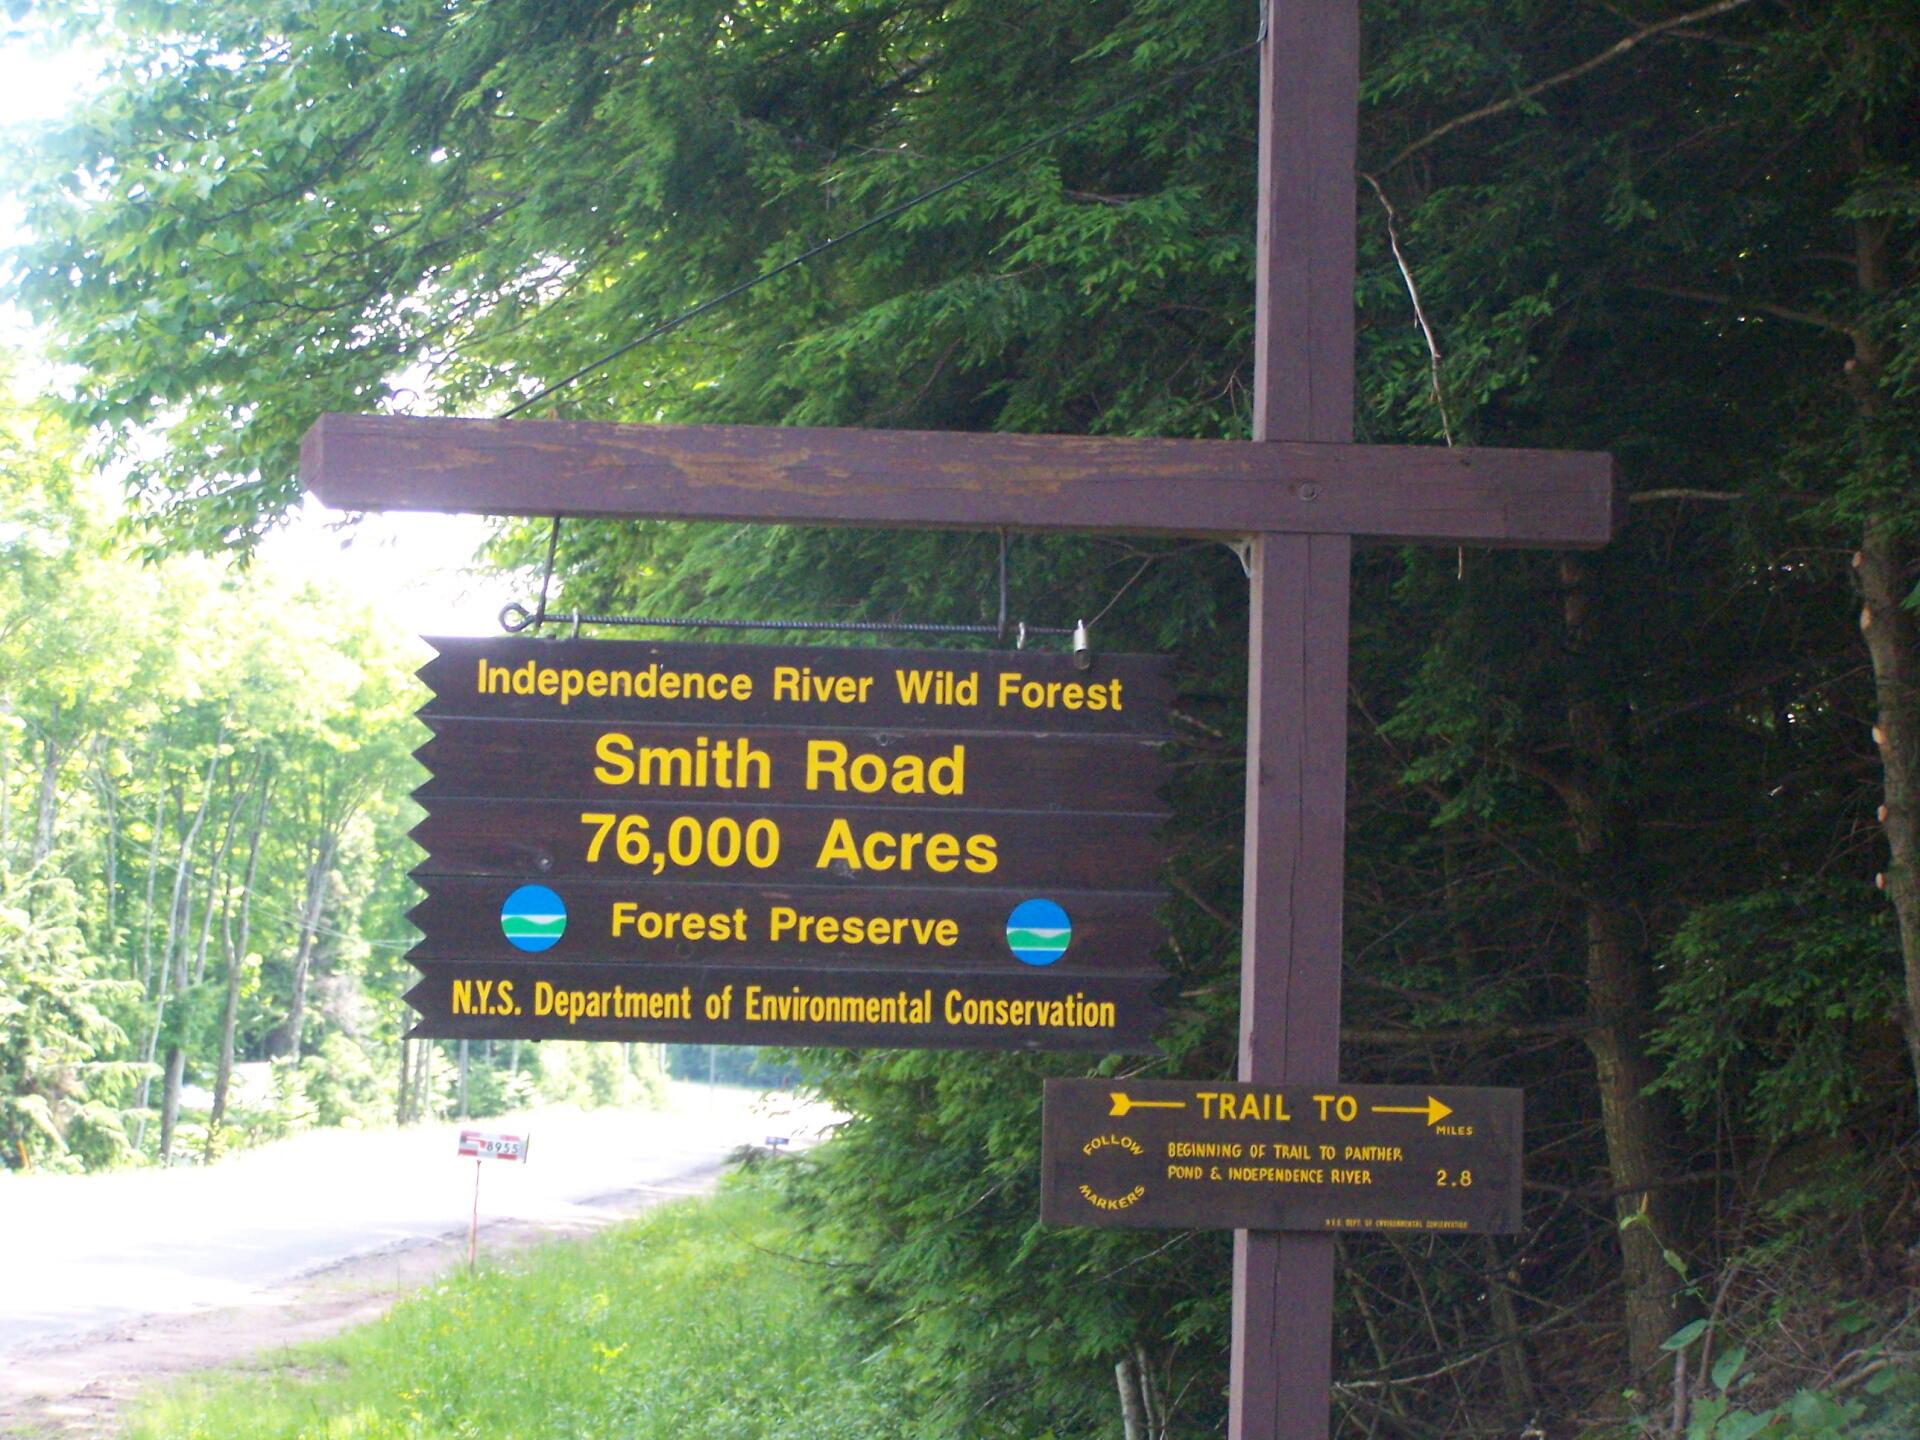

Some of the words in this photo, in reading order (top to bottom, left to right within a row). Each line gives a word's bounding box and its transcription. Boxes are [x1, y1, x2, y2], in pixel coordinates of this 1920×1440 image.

[477, 659, 753, 705] Independence
[773, 666, 874, 704] River
[895, 669, 979, 707] Wild
[998, 672, 1123, 711] Forest
[593, 732, 772, 789] Smith
[804, 739, 966, 796] Road
[580, 812, 781, 876] 76,000
[815, 818, 999, 874] Acres
[611, 901, 748, 942] Forest
[769, 906, 960, 947] Preserve
[451, 979, 522, 1016] N.Y.S.
[533, 980, 692, 1025] Department
[704, 984, 733, 1020] of
[745, 985, 932, 1025] Environmental
[944, 988, 1116, 1027] Conservation
[1195, 1091, 1291, 1121] TRAIL
[1312, 1094, 1358, 1123] TO
[1435, 1125, 1474, 1137] MILES
[486, 1141, 519, 1154] 8955
[1082, 1134, 1143, 1156] FOLLOW
[1167, 1142, 1243, 1158] BEGINNING
[1249, 1144, 1265, 1159] OF
[1273, 1144, 1312, 1160] TRAIL
[1318, 1145, 1336, 1160] TO
[1344, 1146, 1403, 1161] PANTHER
[1167, 1165, 1204, 1180] POND
[1209, 1167, 1222, 1180] &
[1228, 1167, 1324, 1184] INDEPENDENCE
[1330, 1169, 1371, 1185] RIVER
[1436, 1169, 1472, 1187] 2.8
[1078, 1184, 1145, 1210] MARKERS
